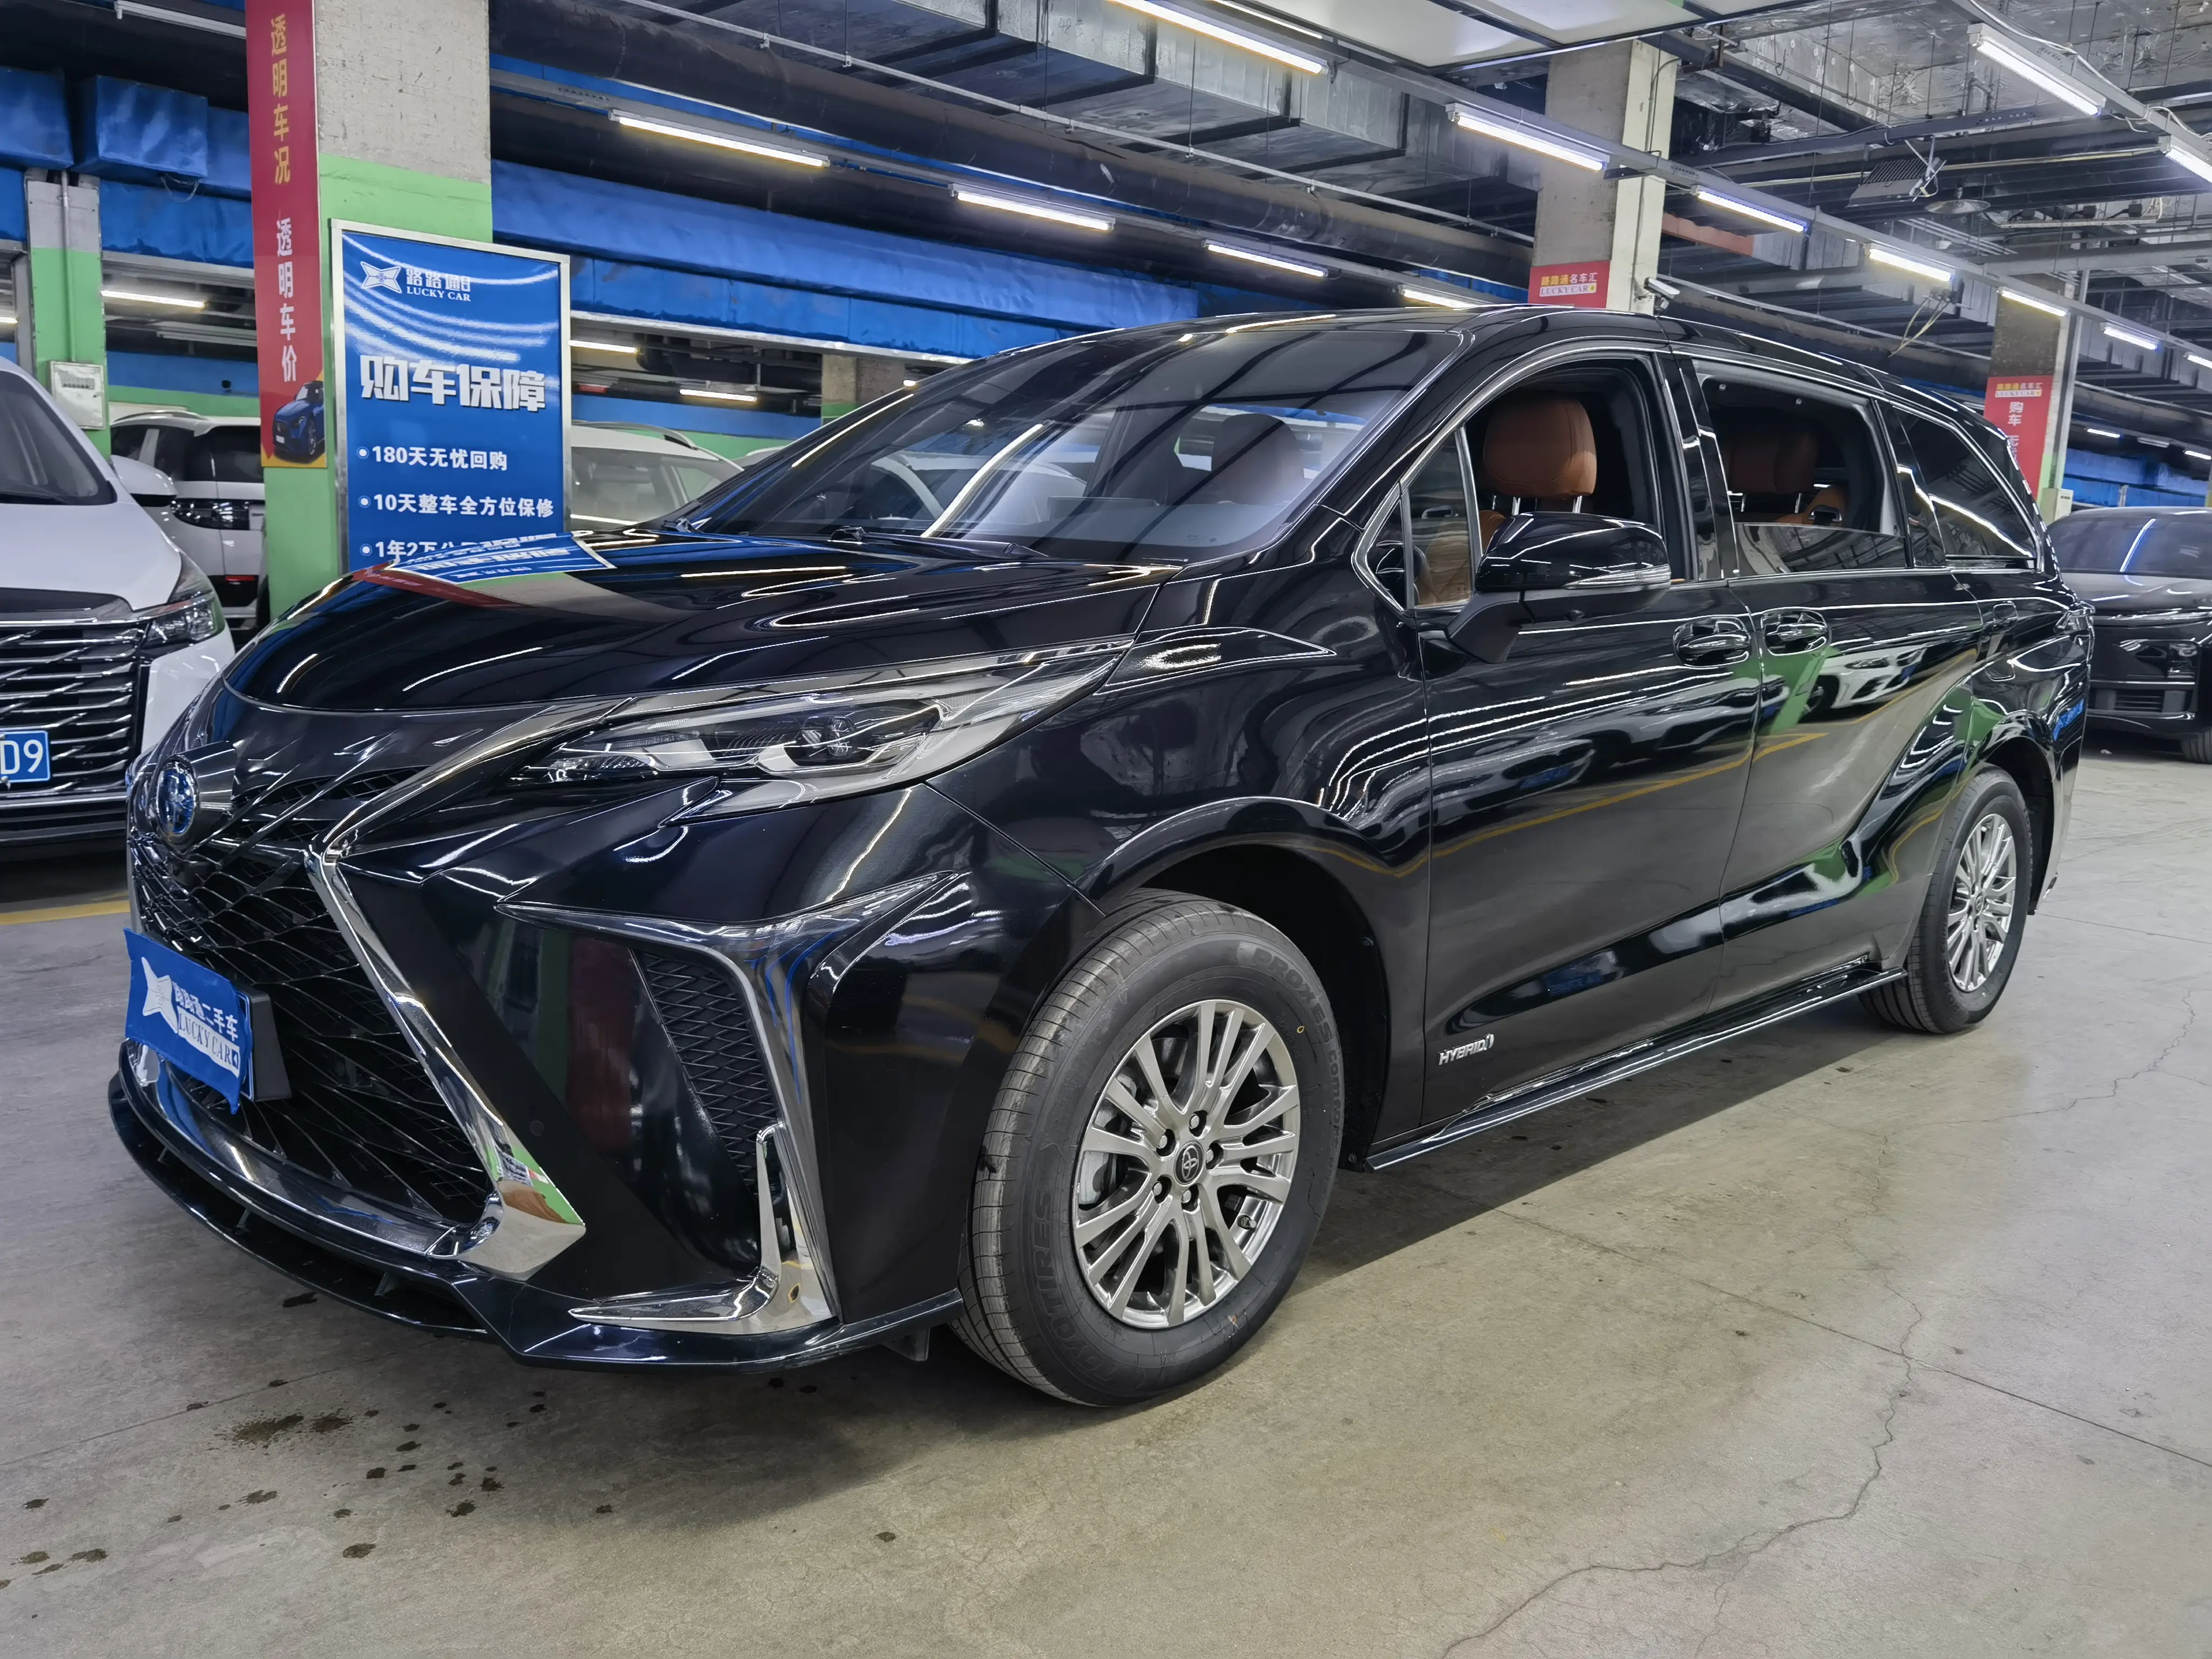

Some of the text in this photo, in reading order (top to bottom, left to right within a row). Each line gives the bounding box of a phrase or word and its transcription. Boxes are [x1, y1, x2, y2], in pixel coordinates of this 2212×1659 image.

[271, 13, 297, 382] 透明车况 透明车价
[406, 286, 471, 302] LUCKY CAR
[1570, 285, 1589, 293] CAR
[360, 354, 546, 412] 购车保障
[372, 446, 508, 471] 180天无忧回购
[374, 494, 554, 518] 10天整车全方位保修
[0, 739, 43, 774] D9
[179, 1013, 232, 1065] LUCKY CAR
[1438, 1037, 1487, 1066] HYBRID
